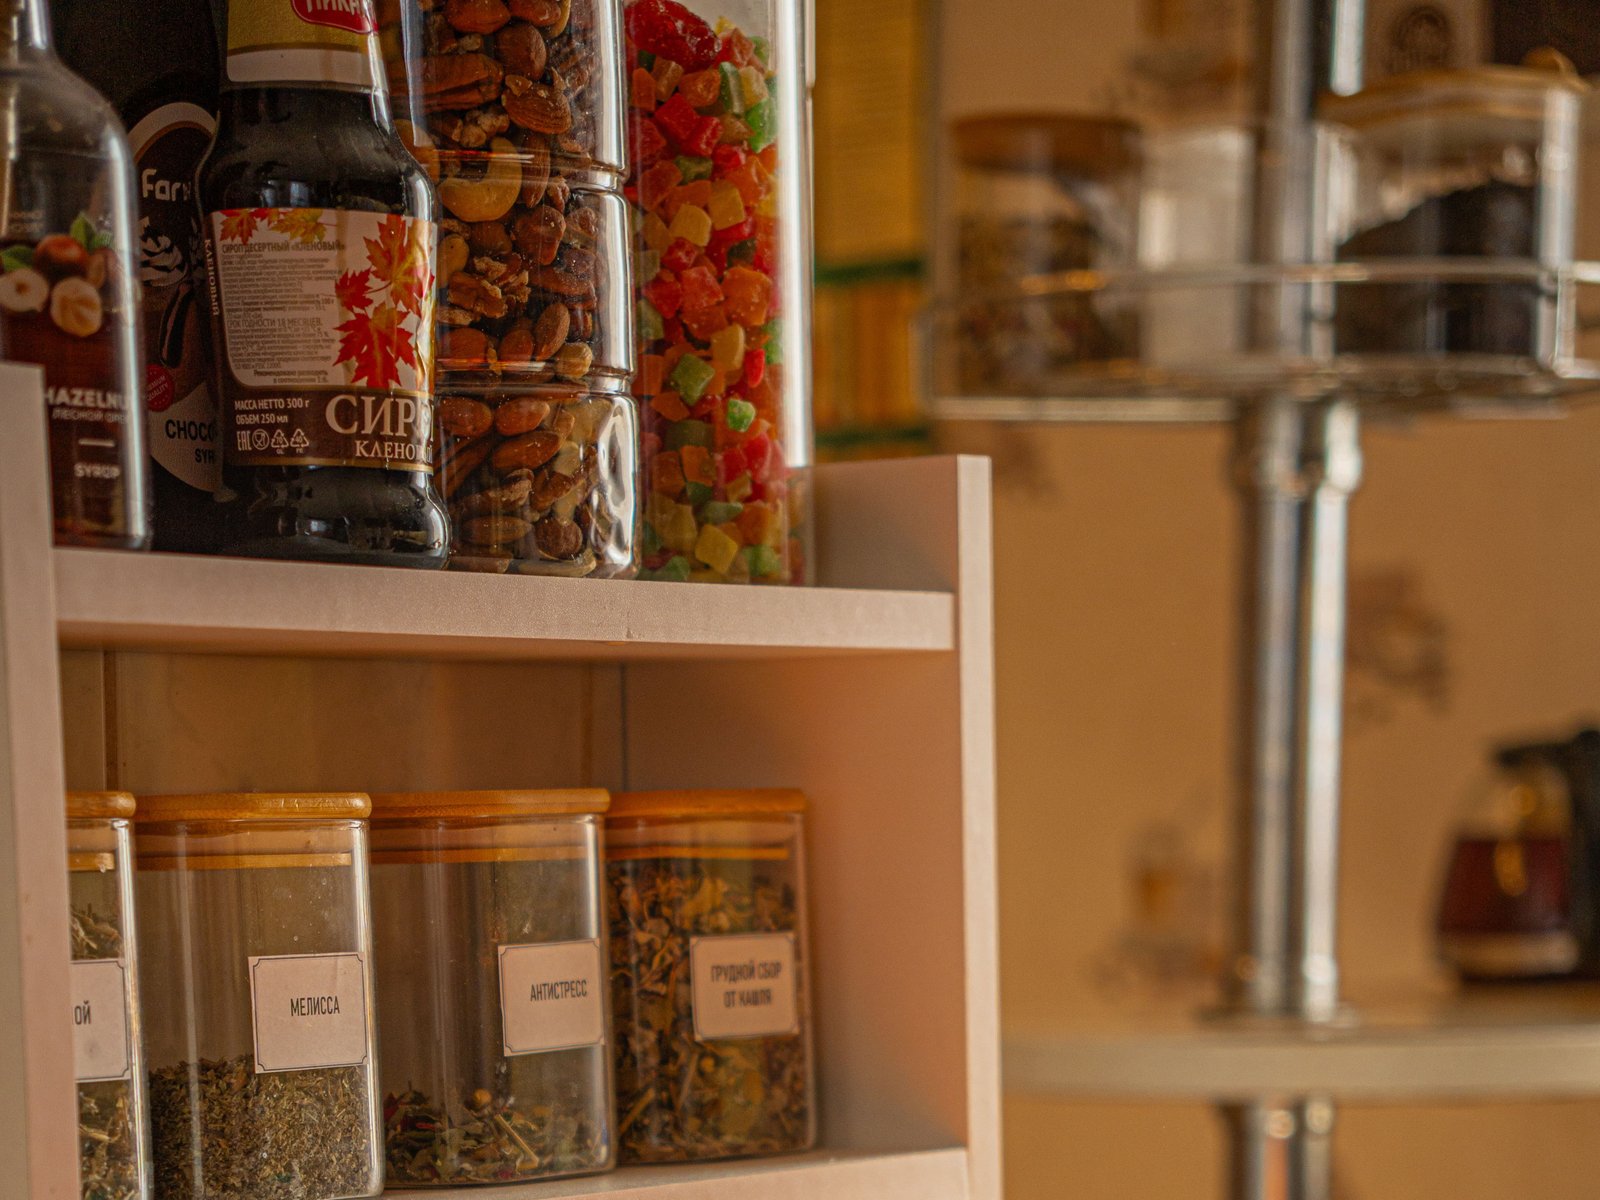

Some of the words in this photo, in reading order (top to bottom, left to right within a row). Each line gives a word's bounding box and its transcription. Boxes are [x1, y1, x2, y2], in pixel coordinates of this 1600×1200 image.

[234, 399, 257, 410] МАССА
[258, 398, 285, 409] НЕТТО
[286, 398, 303, 409] 300
[235, 414, 259, 425] ОБЪЕМ
[260, 413, 276, 424] 250
[276, 415, 289, 423] мл
[711, 959, 755, 984] ГРУДНОЙ
[757, 961, 782, 980] СБОР
[530, 979, 588, 1002] АНТИСТРЕСС
[724, 990, 736, 1008] ОТ
[739, 988, 771, 1007] КАШЛЯ
[74, 1000, 92, 1025] ОЙ
[290, 996, 340, 1017] МЕЛИССА
